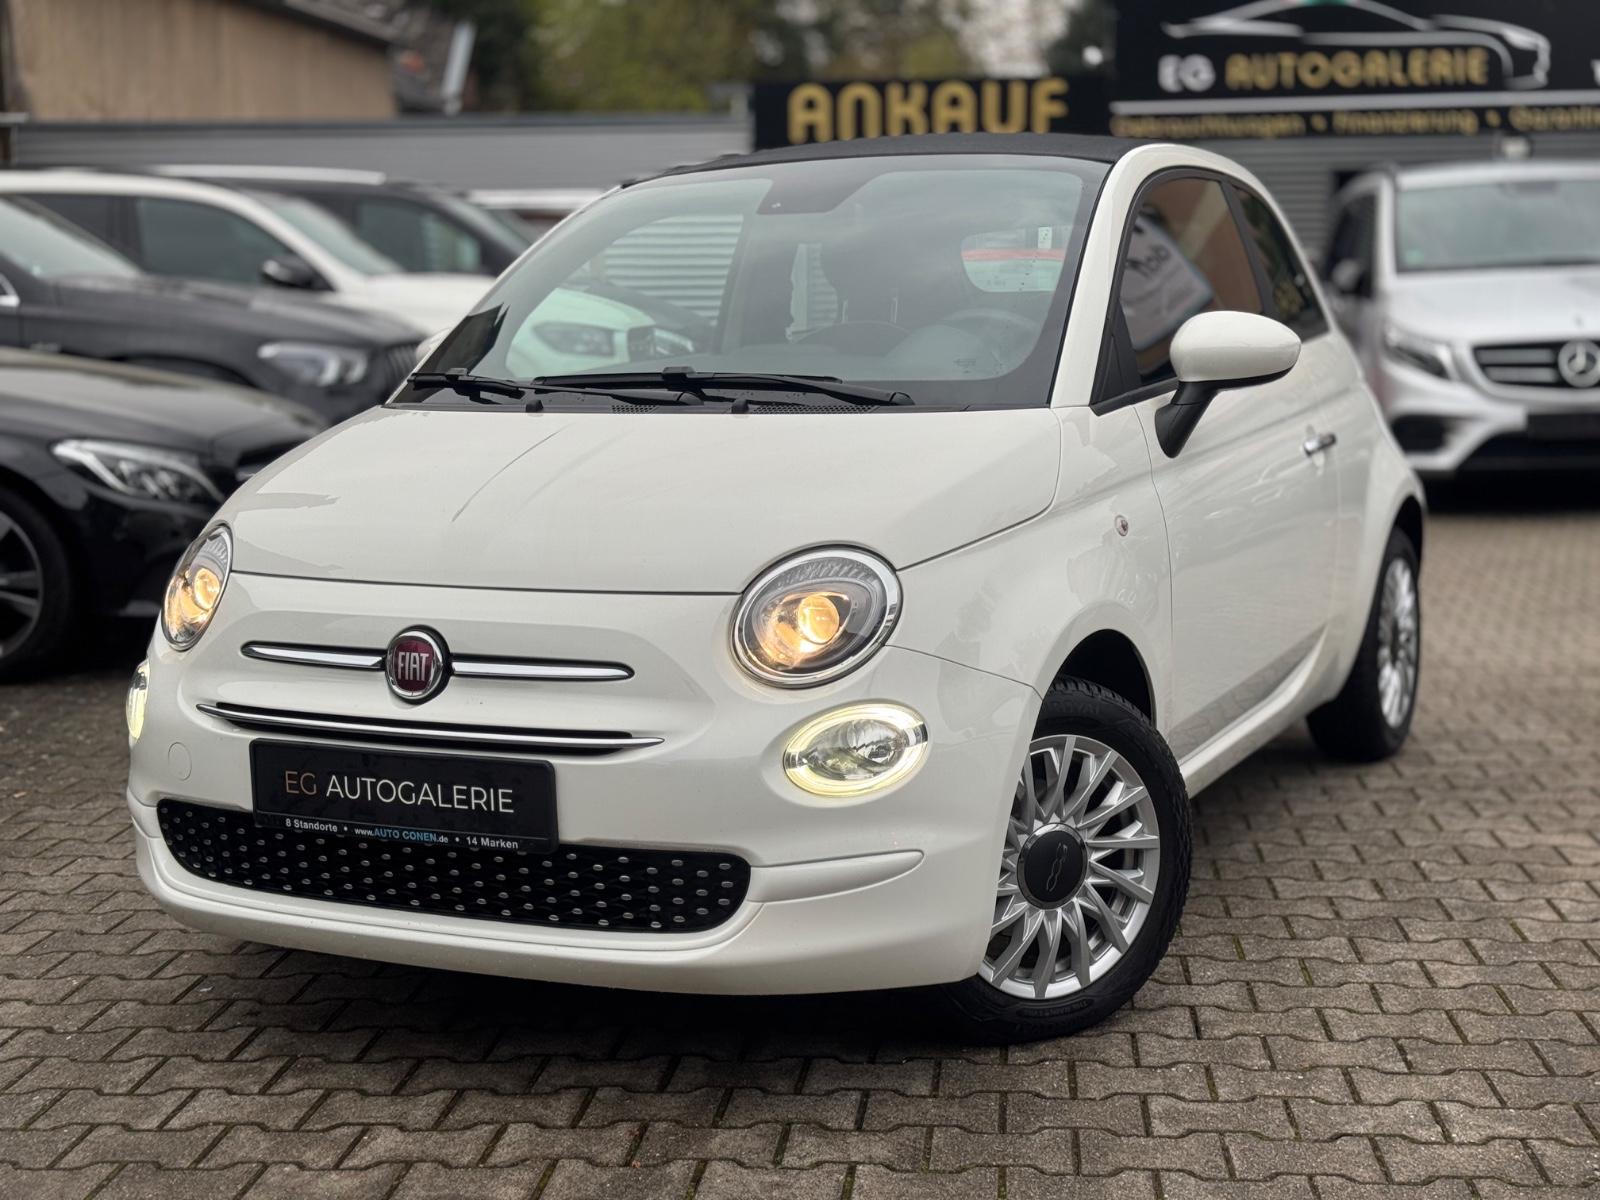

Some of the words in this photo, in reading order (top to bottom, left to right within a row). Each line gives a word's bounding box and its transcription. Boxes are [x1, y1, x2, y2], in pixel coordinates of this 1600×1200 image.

[1157, 54, 1216, 92] EG
[1225, 47, 1489, 90] AUTOGALERIE
[787, 76, 1069, 144] ANKAUF
[397, 651, 430, 681] FIAT
[285, 770, 318, 795] EG
[326, 774, 515, 813] AUTOGALERIE
[285, 818, 291, 828] 8
[293, 819, 338, 833] Standorte
[466, 836, 478, 845] 14
[480, 837, 519, 849] Marken
